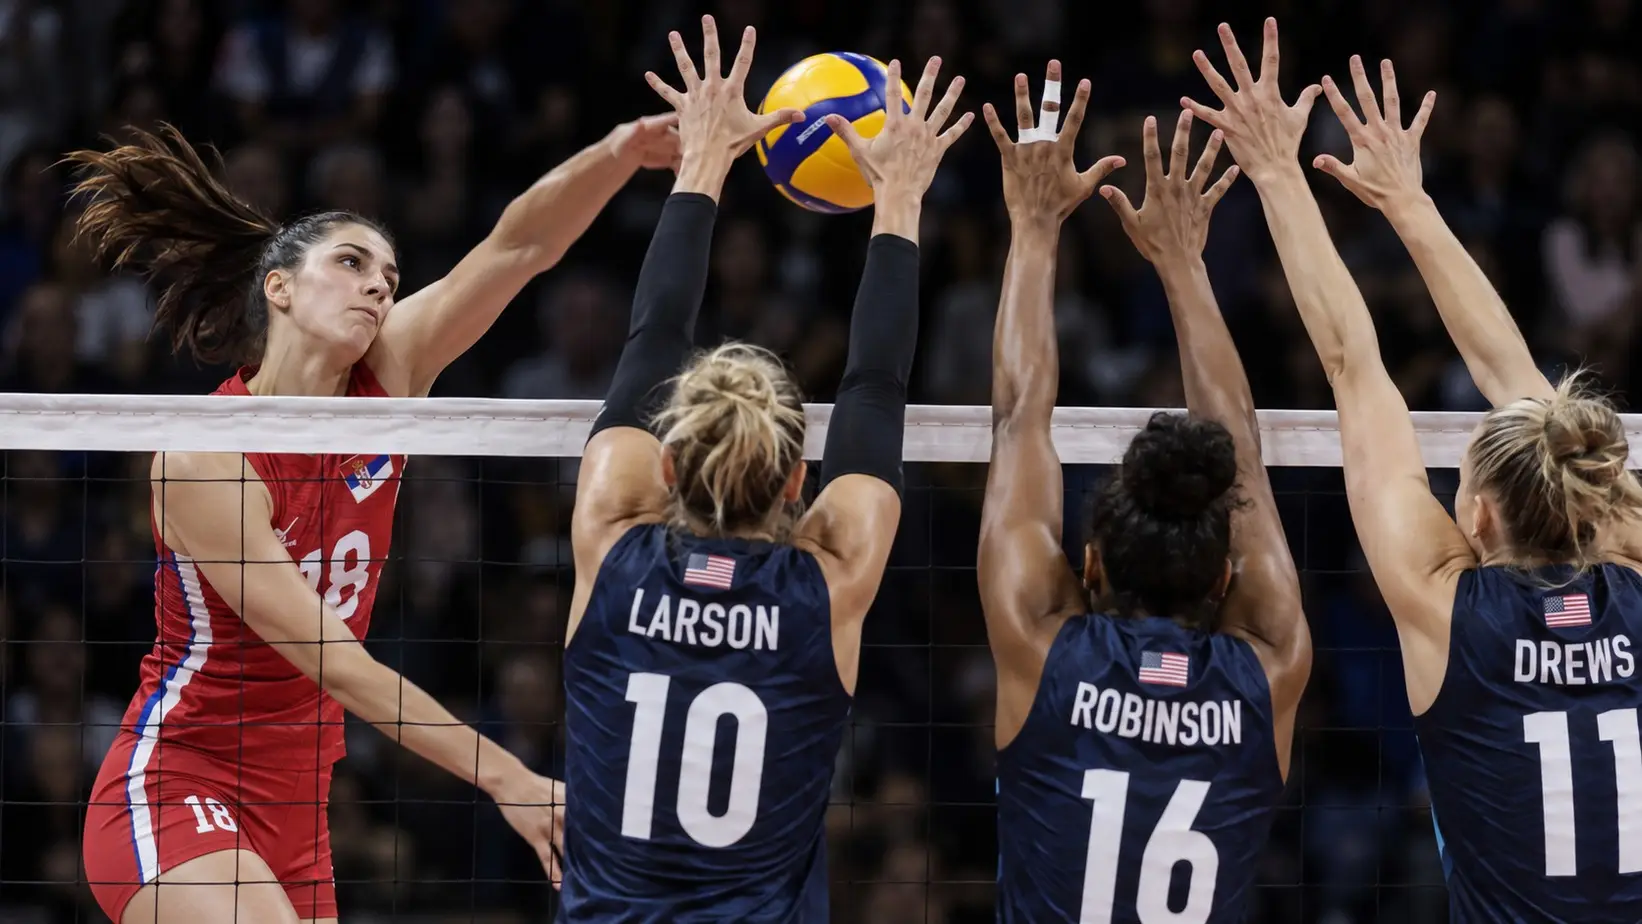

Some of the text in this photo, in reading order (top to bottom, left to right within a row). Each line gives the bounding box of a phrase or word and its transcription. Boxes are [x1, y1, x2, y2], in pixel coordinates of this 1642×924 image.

[627, 587, 780, 651] LARSON
[1513, 634, 1636, 685] DREWS
[1069, 681, 1241, 746] ROBINSON
[620, 671, 769, 848] 10
[1522, 707, 1642, 877] 11
[184, 794, 238, 834] 18
[1078, 768, 1220, 924] 16
